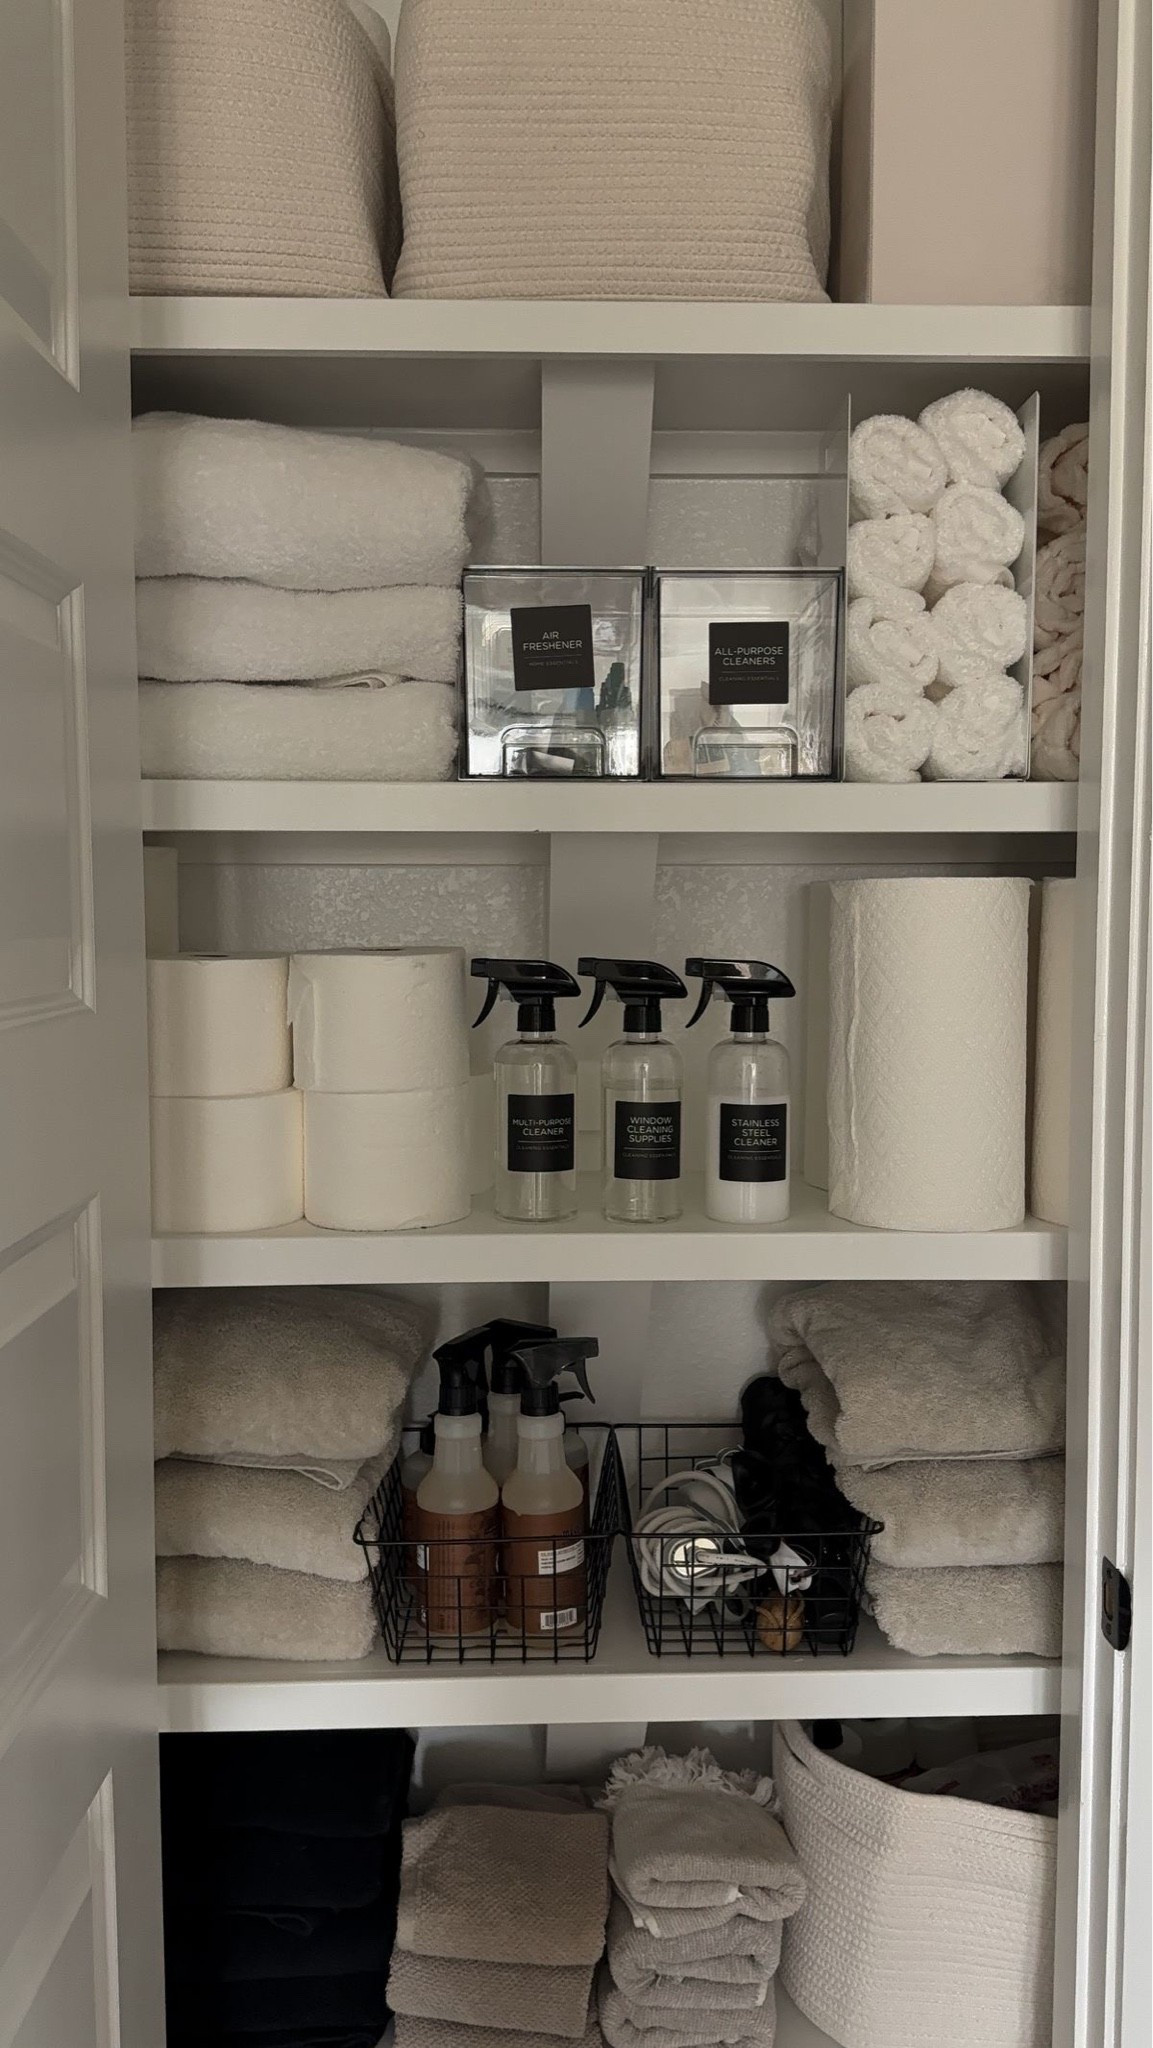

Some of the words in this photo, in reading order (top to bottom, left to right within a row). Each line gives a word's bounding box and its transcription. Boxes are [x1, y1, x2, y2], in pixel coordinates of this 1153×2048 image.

[542, 631, 560, 640] AIR
[523, 640, 583, 651] FRESHENER
[714, 646, 784, 656] ALL-PURPOSE
[722, 657, 776, 666] CLEANERS
[512, 1117, 572, 1126] MULTI-PURPOSE
[629, 1116, 673, 1125] WINDOW
[731, 1118, 780, 1127] STAINLESS
[522, 1127, 564, 1136] CLEANER
[626, 1125, 674, 1134] CLEANING
[742, 1128, 772, 1137] STEEL
[628, 1134, 672, 1143] SUPPLIES
[733, 1137, 778, 1146] CLEANER
